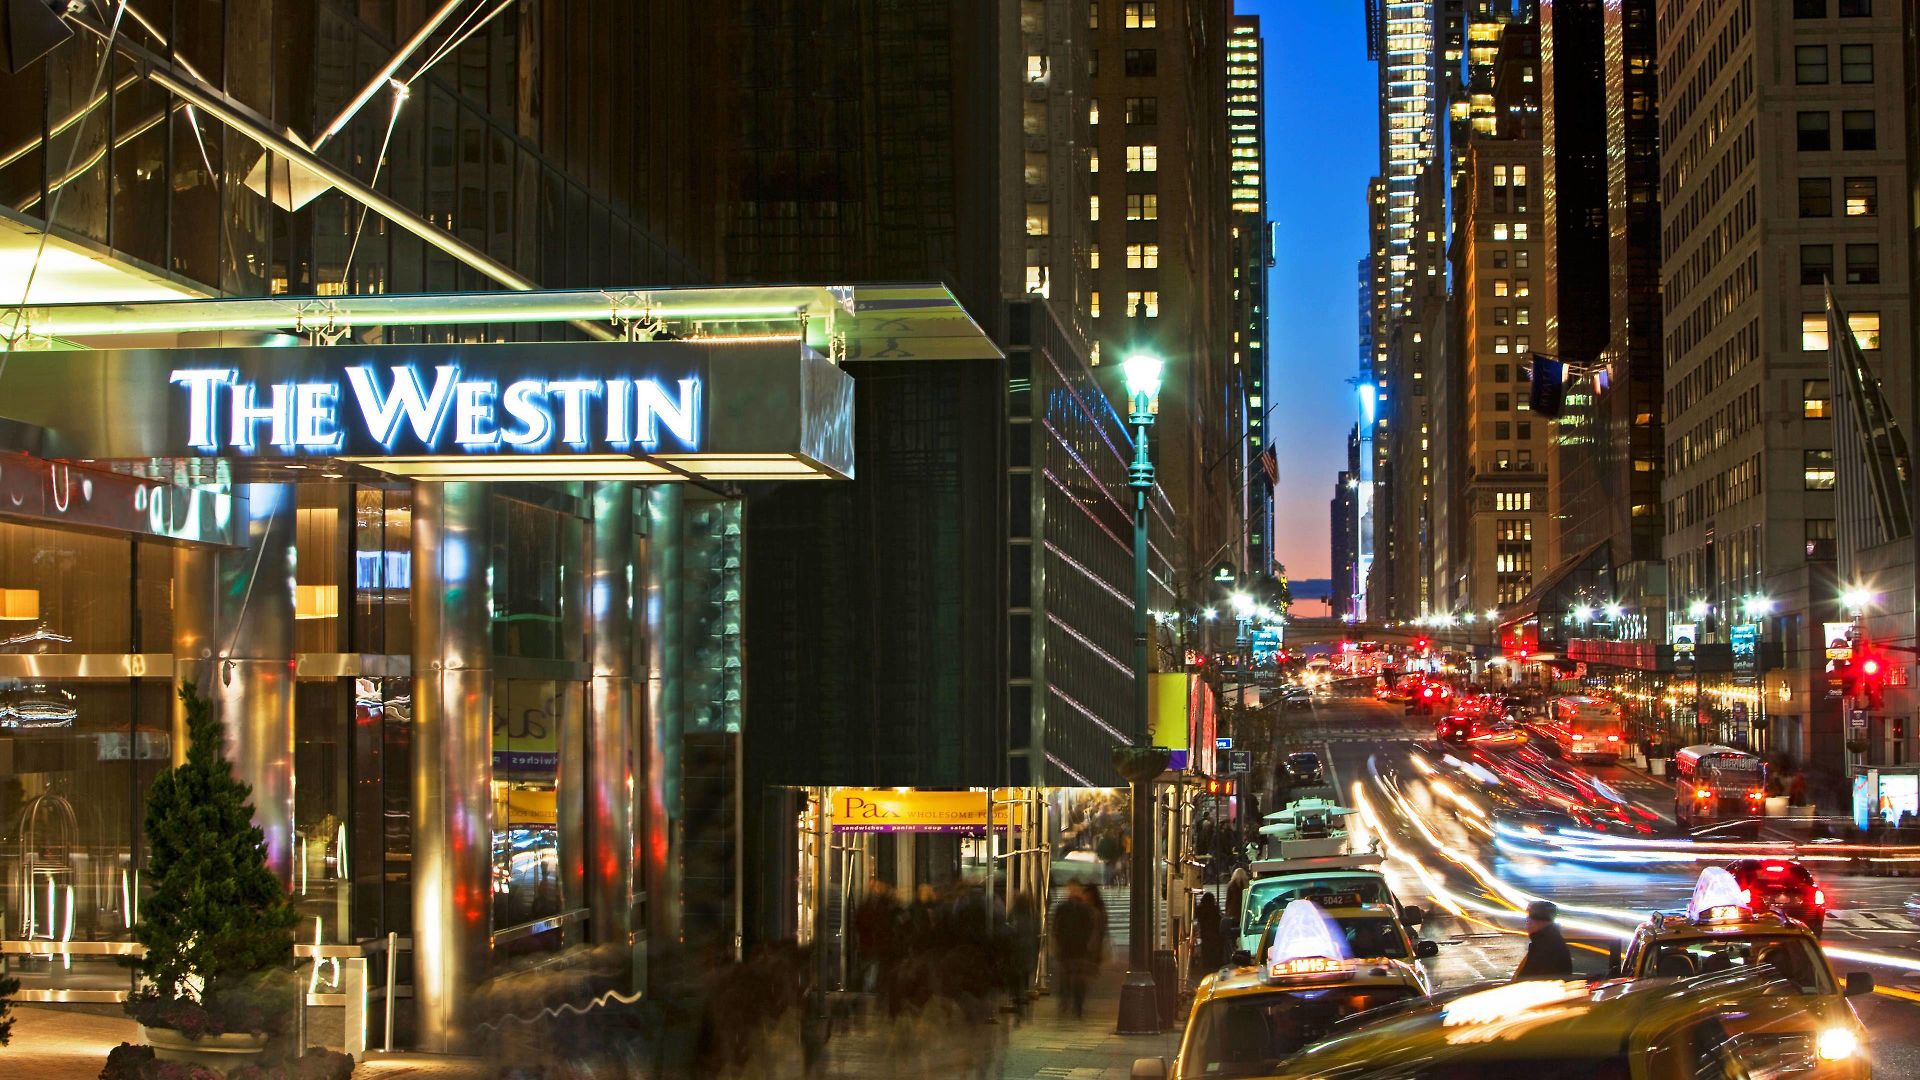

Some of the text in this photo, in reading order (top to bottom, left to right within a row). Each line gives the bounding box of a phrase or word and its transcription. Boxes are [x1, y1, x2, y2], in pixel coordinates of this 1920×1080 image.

[170, 364, 701, 450] THE WESTIN
[843, 797, 901, 819] Pax
[907, 811, 975, 819] WHOLESOME
